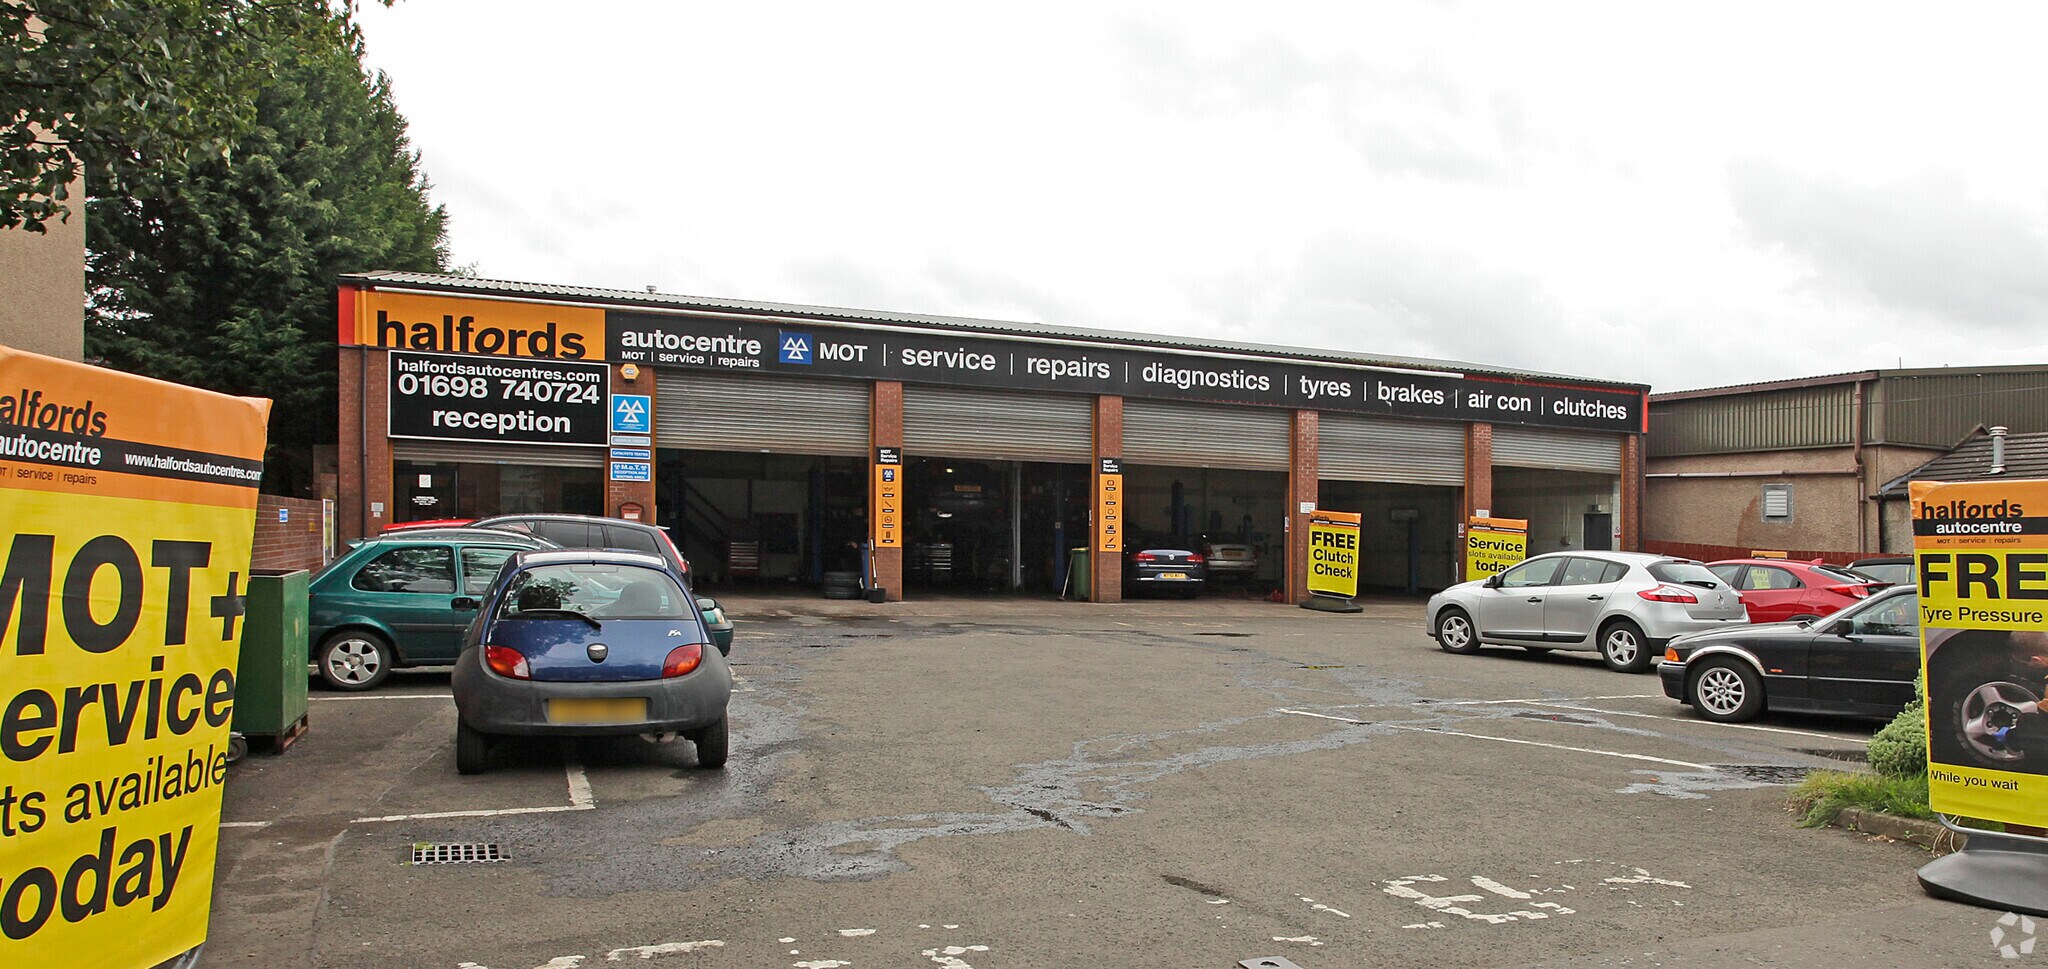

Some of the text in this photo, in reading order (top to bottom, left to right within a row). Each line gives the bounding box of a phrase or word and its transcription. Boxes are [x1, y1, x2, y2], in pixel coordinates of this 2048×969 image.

[377, 310, 586, 359] halfords
[621, 329, 761, 355] autocentre
[621, 351, 760, 368] MOT service repairs
[398, 359, 600, 382] halfordsautocentres.com
[399, 374, 600, 404] 01698 740724
[819, 343, 1627, 420] MOT service repairs diagnostics tyres brakes air con clutches
[0, 388, 107, 437] alfords
[433, 409, 571, 434] reception
[17, 467, 54, 481] service
[63, 472, 97, 486] repairs
[1921, 499, 2023, 519] halfords
[1936, 521, 2022, 534] autocentre
[1311, 531, 1355, 550] FREE
[1469, 537, 1523, 552] Service
[1994, 537, 2021, 545] repairs
[1313, 549, 1353, 564] Clutch
[1468, 550, 1523, 562] slots available
[1314, 563, 1352, 579] Check
[1475, 560, 1511, 573] toda
[1920, 553, 2048, 599] FRE
[1921, 605, 2043, 623] Tyre Pressure
[0, 656, 236, 762] ervice
[65, 745, 227, 824] available
[1964, 776, 1987, 787] you
[1991, 780, 2018, 791] wait
[0, 824, 194, 940] oday
